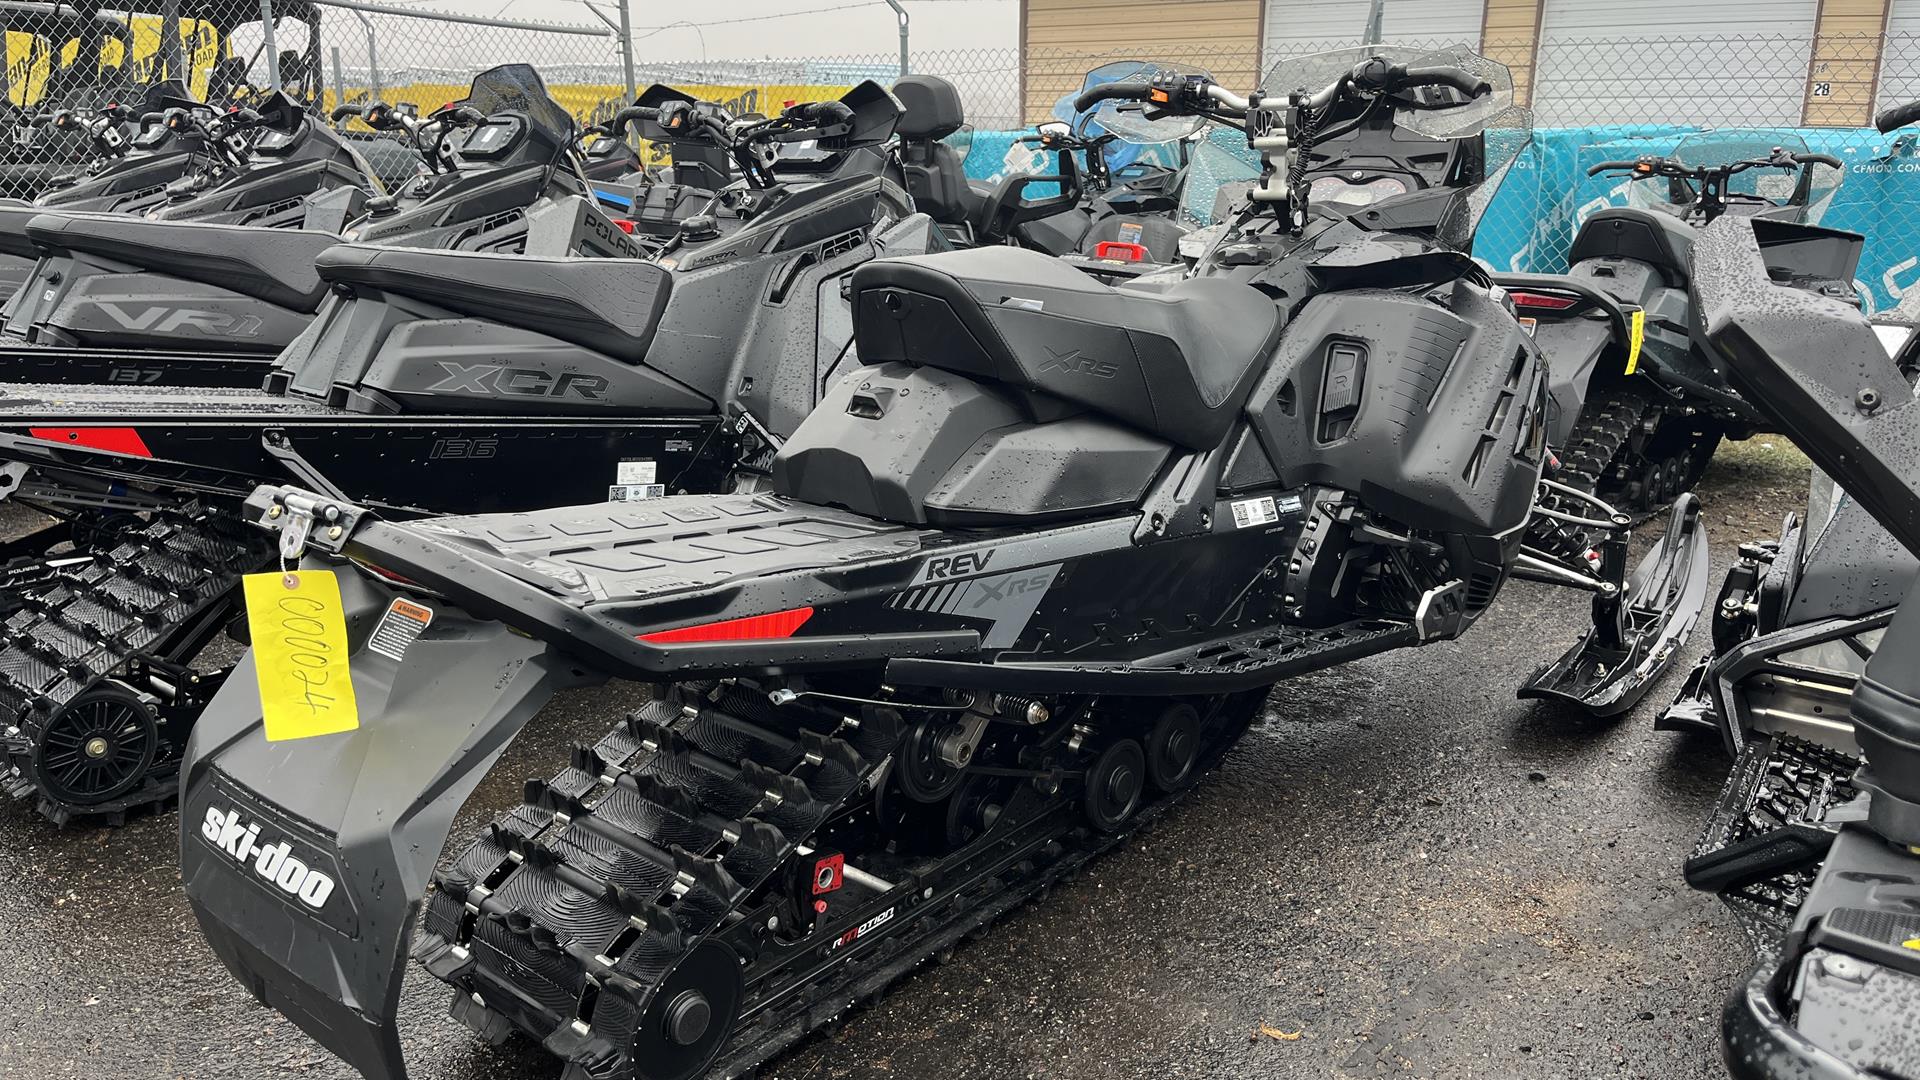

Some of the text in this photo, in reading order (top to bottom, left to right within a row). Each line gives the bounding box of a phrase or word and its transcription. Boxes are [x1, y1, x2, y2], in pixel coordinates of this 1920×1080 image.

[1814, 83, 1830, 96] 28
[108, 368, 163, 383] 137
[1038, 344, 1120, 379] XRS
[425, 361, 610, 401] XCR
[429, 439, 499, 459] 136
[8, 564, 40, 575] POLARIS
[926, 548, 996, 581] REV
[971, 573, 1050, 609] XRS
[201, 806, 335, 909] ski-doo
